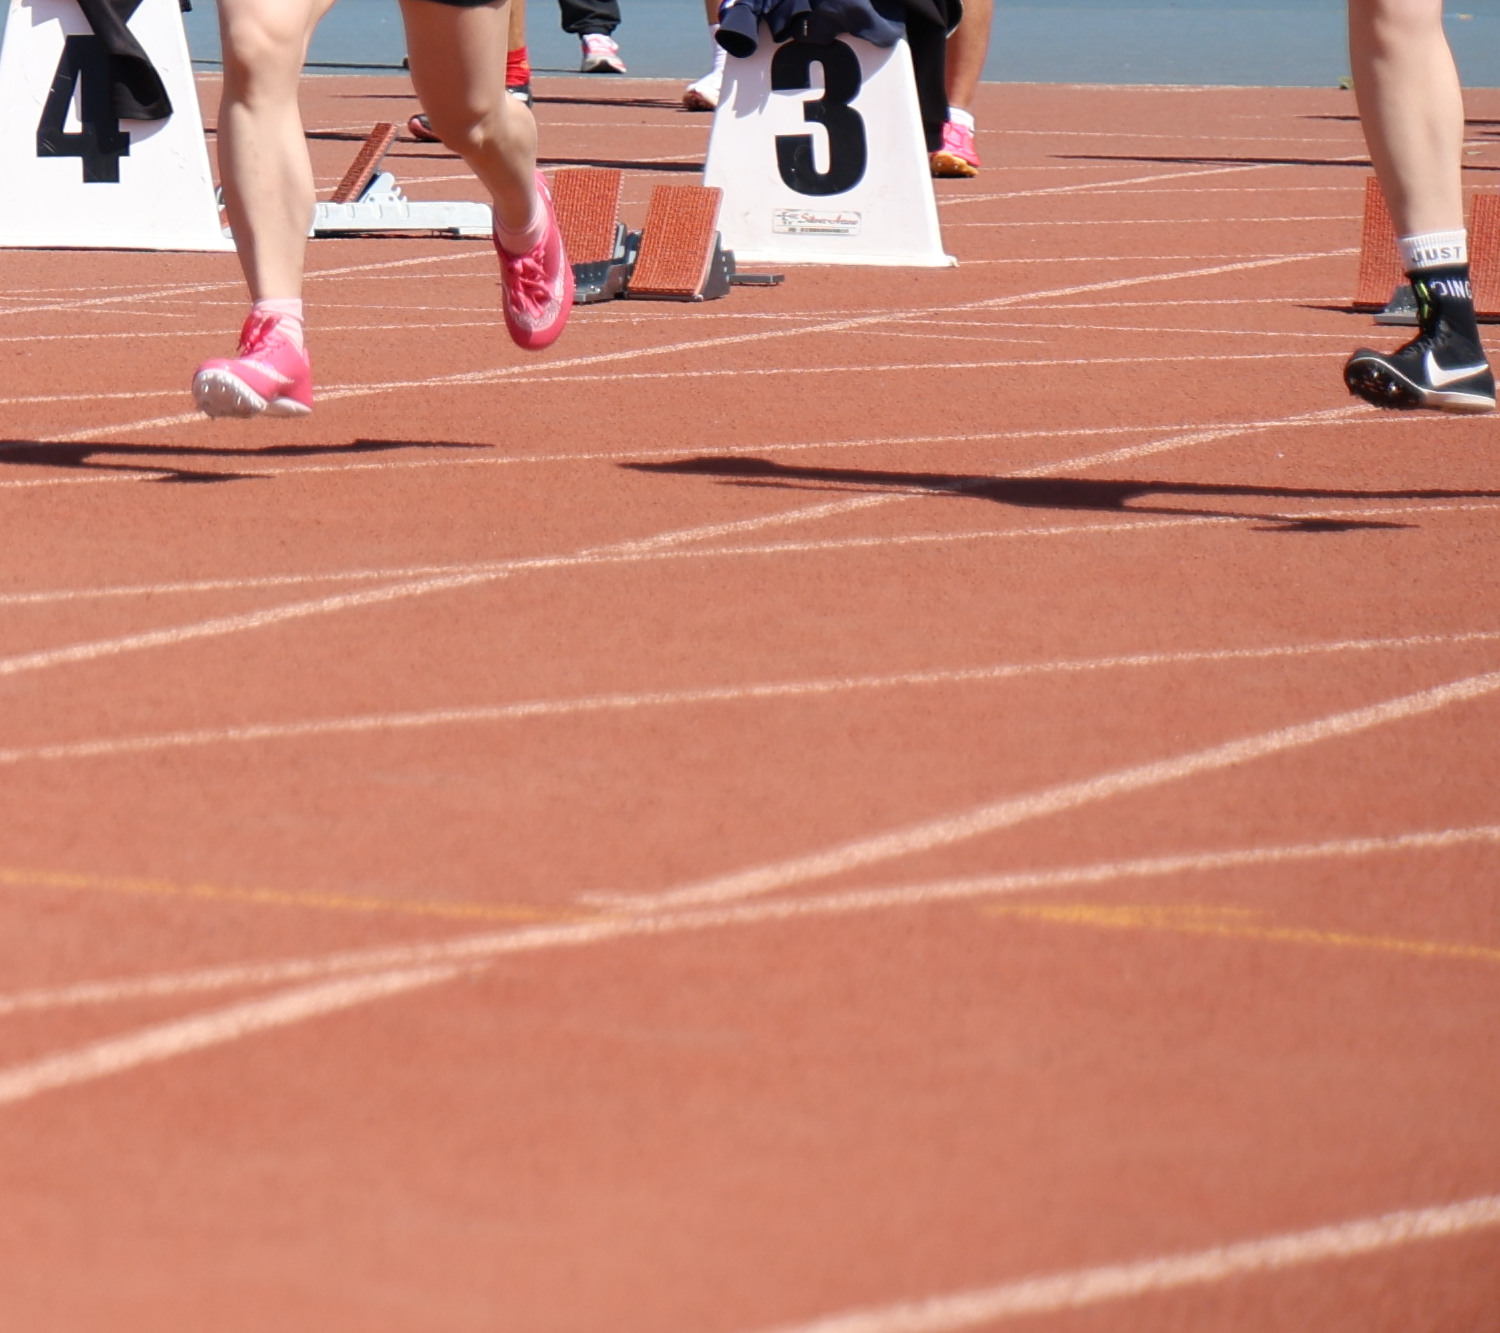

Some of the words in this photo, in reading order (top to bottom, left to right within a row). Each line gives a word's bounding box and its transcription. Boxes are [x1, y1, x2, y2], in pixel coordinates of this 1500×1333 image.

[36, 35, 130, 183] 4
[771, 37, 868, 197] 3
[1411, 246, 1462, 263] JUST
